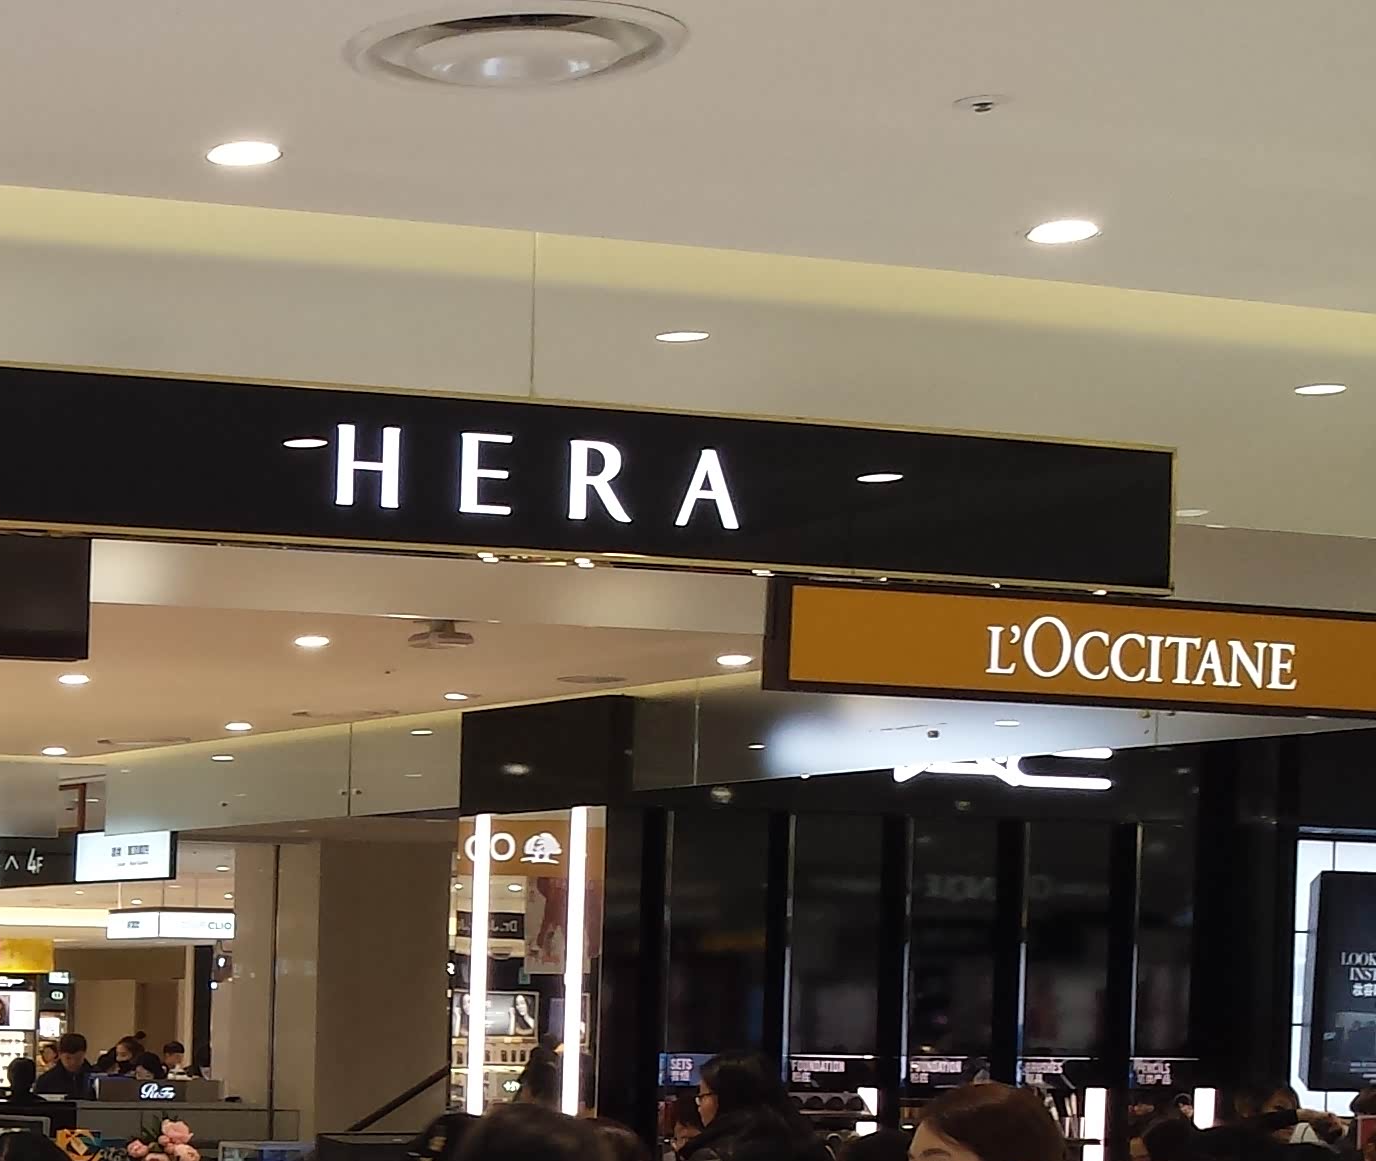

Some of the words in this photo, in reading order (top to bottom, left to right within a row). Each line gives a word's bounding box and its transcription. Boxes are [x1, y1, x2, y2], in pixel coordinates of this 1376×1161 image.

[333, 422, 739, 529] HERA
[986, 616, 1299, 691] L'OCCITANE
[670, 1058, 694, 1071] SETS
[791, 1060, 846, 1073] FOUNDATION
